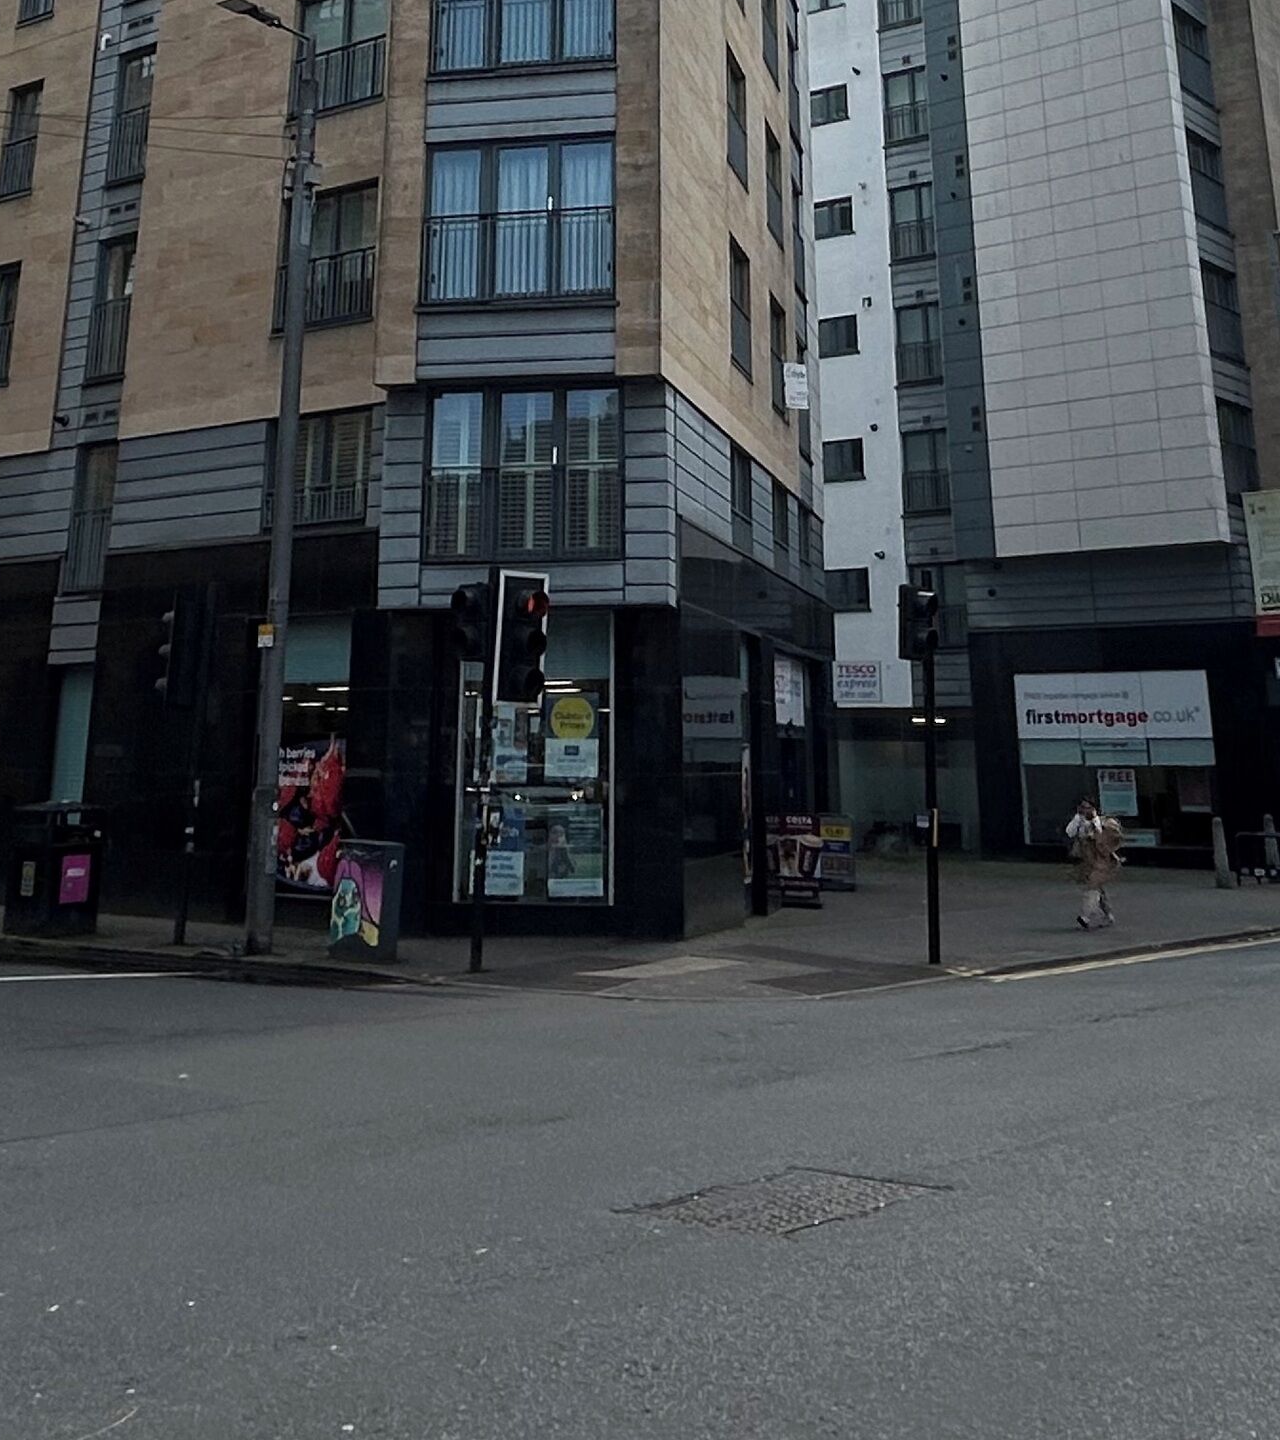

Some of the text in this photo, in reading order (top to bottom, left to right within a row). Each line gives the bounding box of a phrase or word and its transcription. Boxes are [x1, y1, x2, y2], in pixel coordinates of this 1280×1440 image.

[837, 664, 876, 674] TESCO
[286, 746, 316, 759] berries
[1099, 771, 1133, 782] FREE
[785, 815, 813, 825] COSTA
